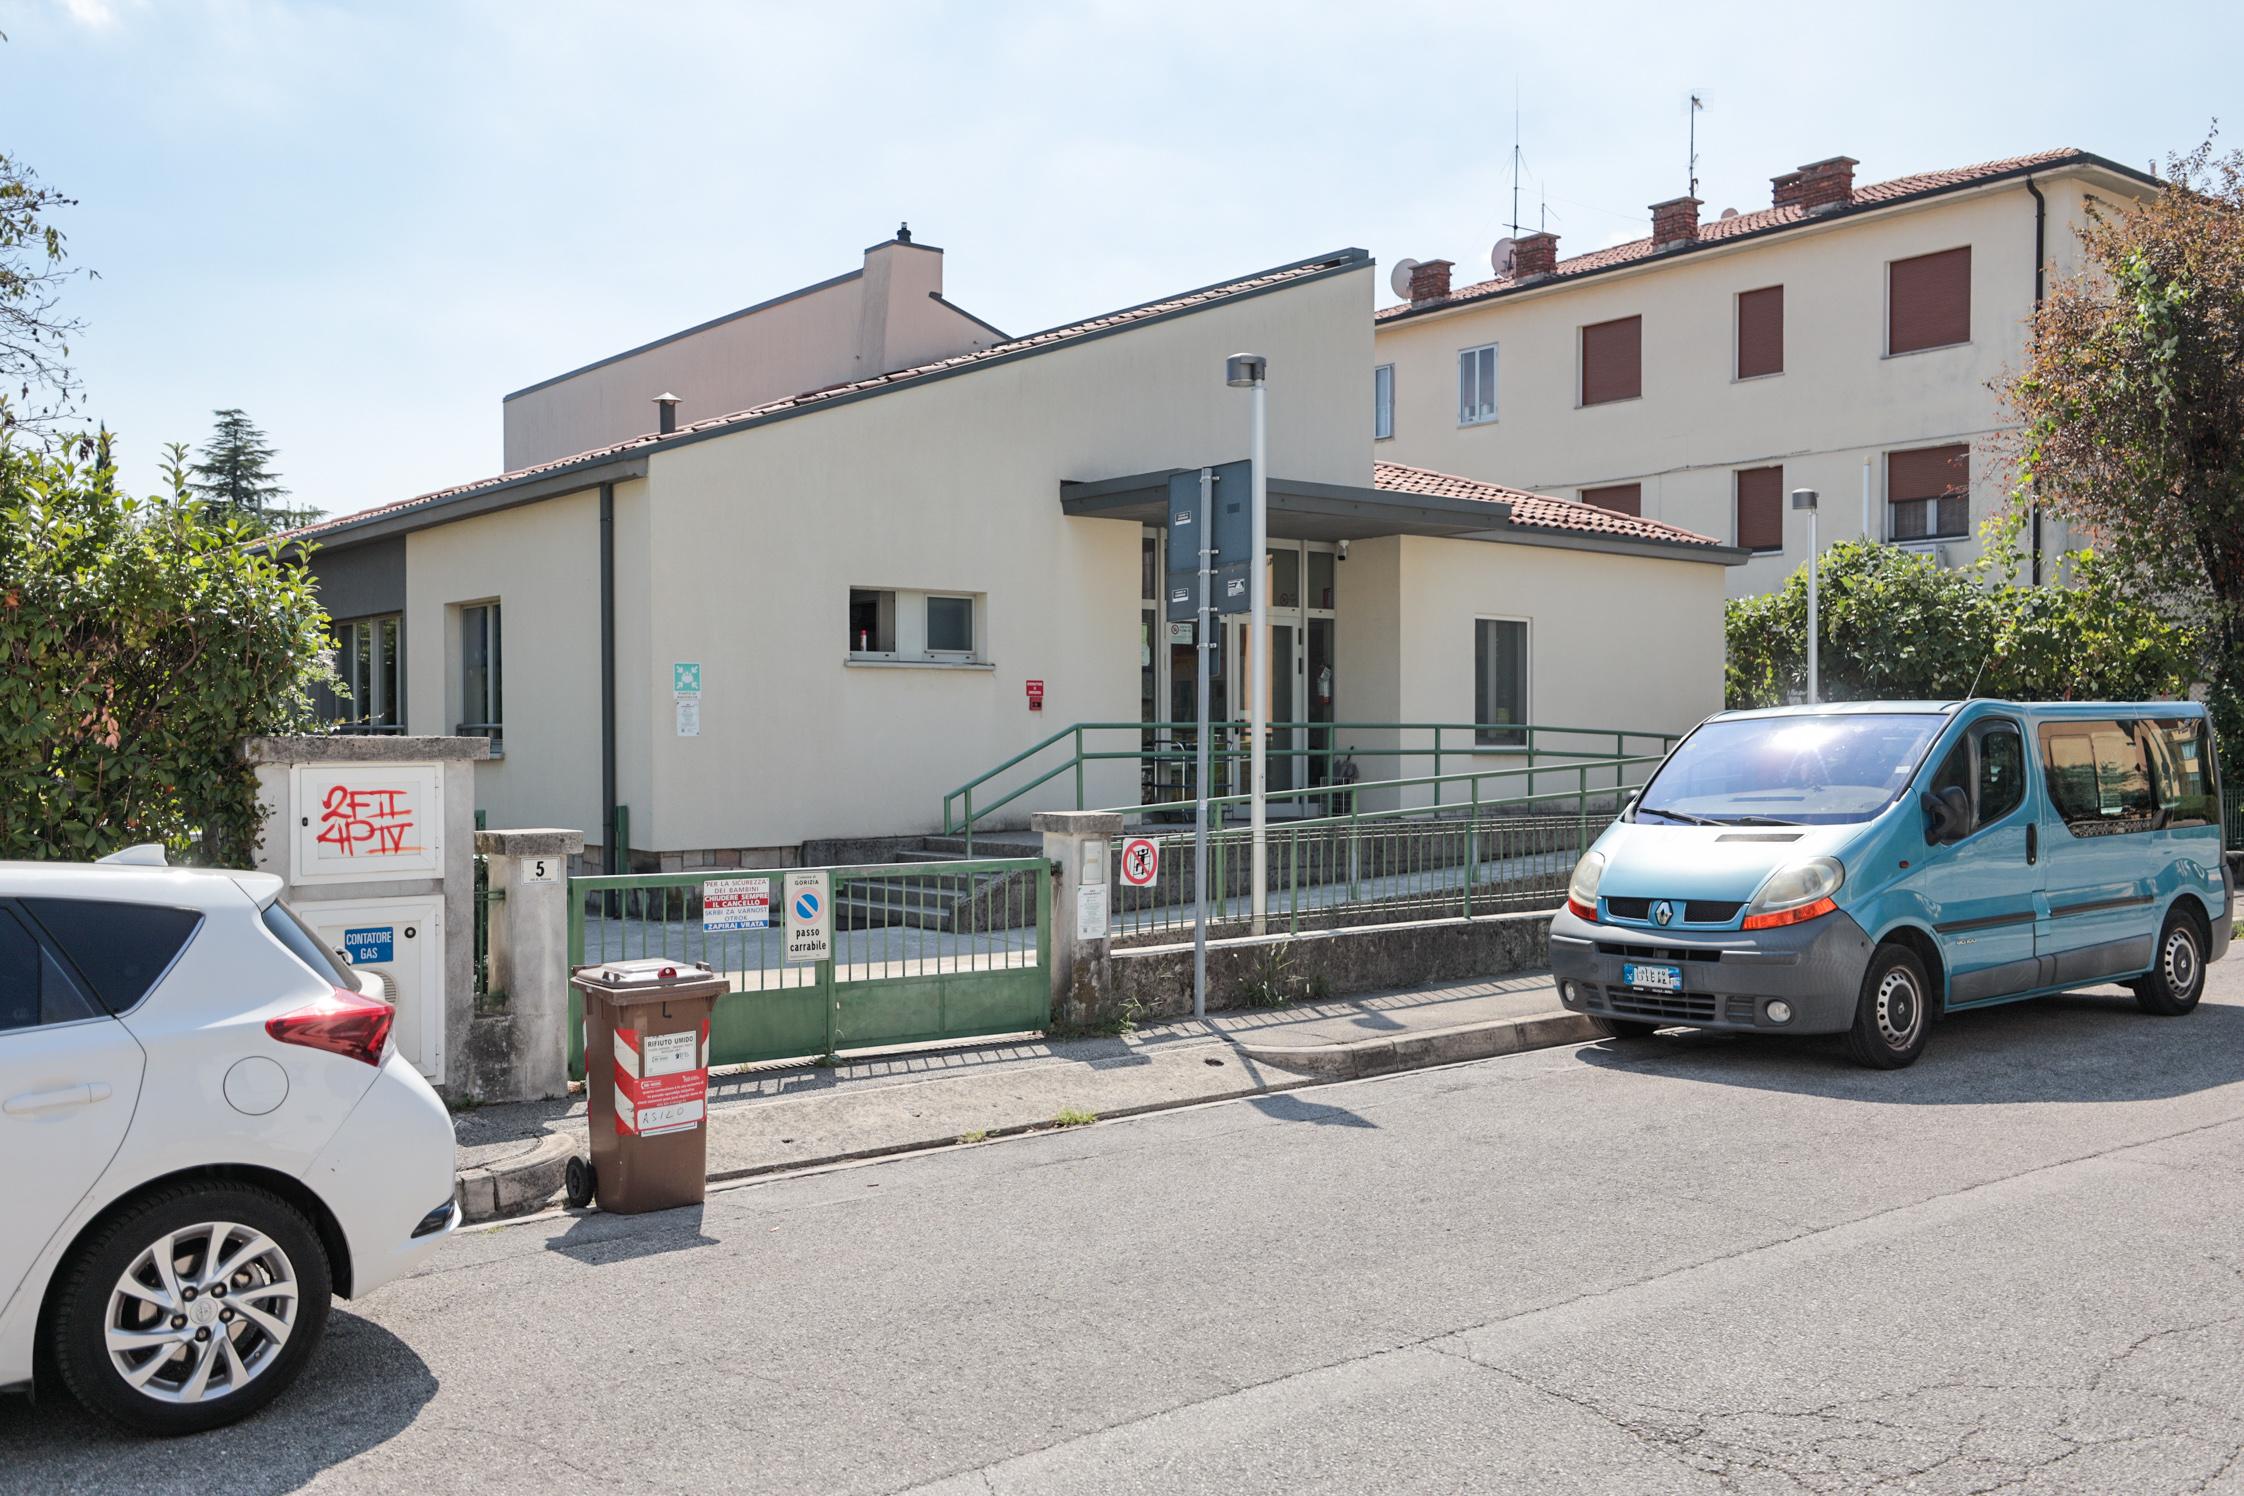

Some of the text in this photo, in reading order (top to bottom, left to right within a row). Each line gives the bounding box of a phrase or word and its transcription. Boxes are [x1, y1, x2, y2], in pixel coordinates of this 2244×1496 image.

[535, 860, 545, 878] 5
[704, 892, 769, 902] CHIUDERE SEMPRE
[722, 899, 761, 907] CANCELLO
[737, 906, 768, 914] VARNOST
[708, 922, 738, 930] ZAPIRAJ
[345, 930, 392, 946] CONTATORE
[796, 928, 820, 940] passo
[790, 940, 827, 952] carrabile
[360, 947, 378, 960] GAS
[647, 1036, 694, 1048] RIFIUTO UMIDO
